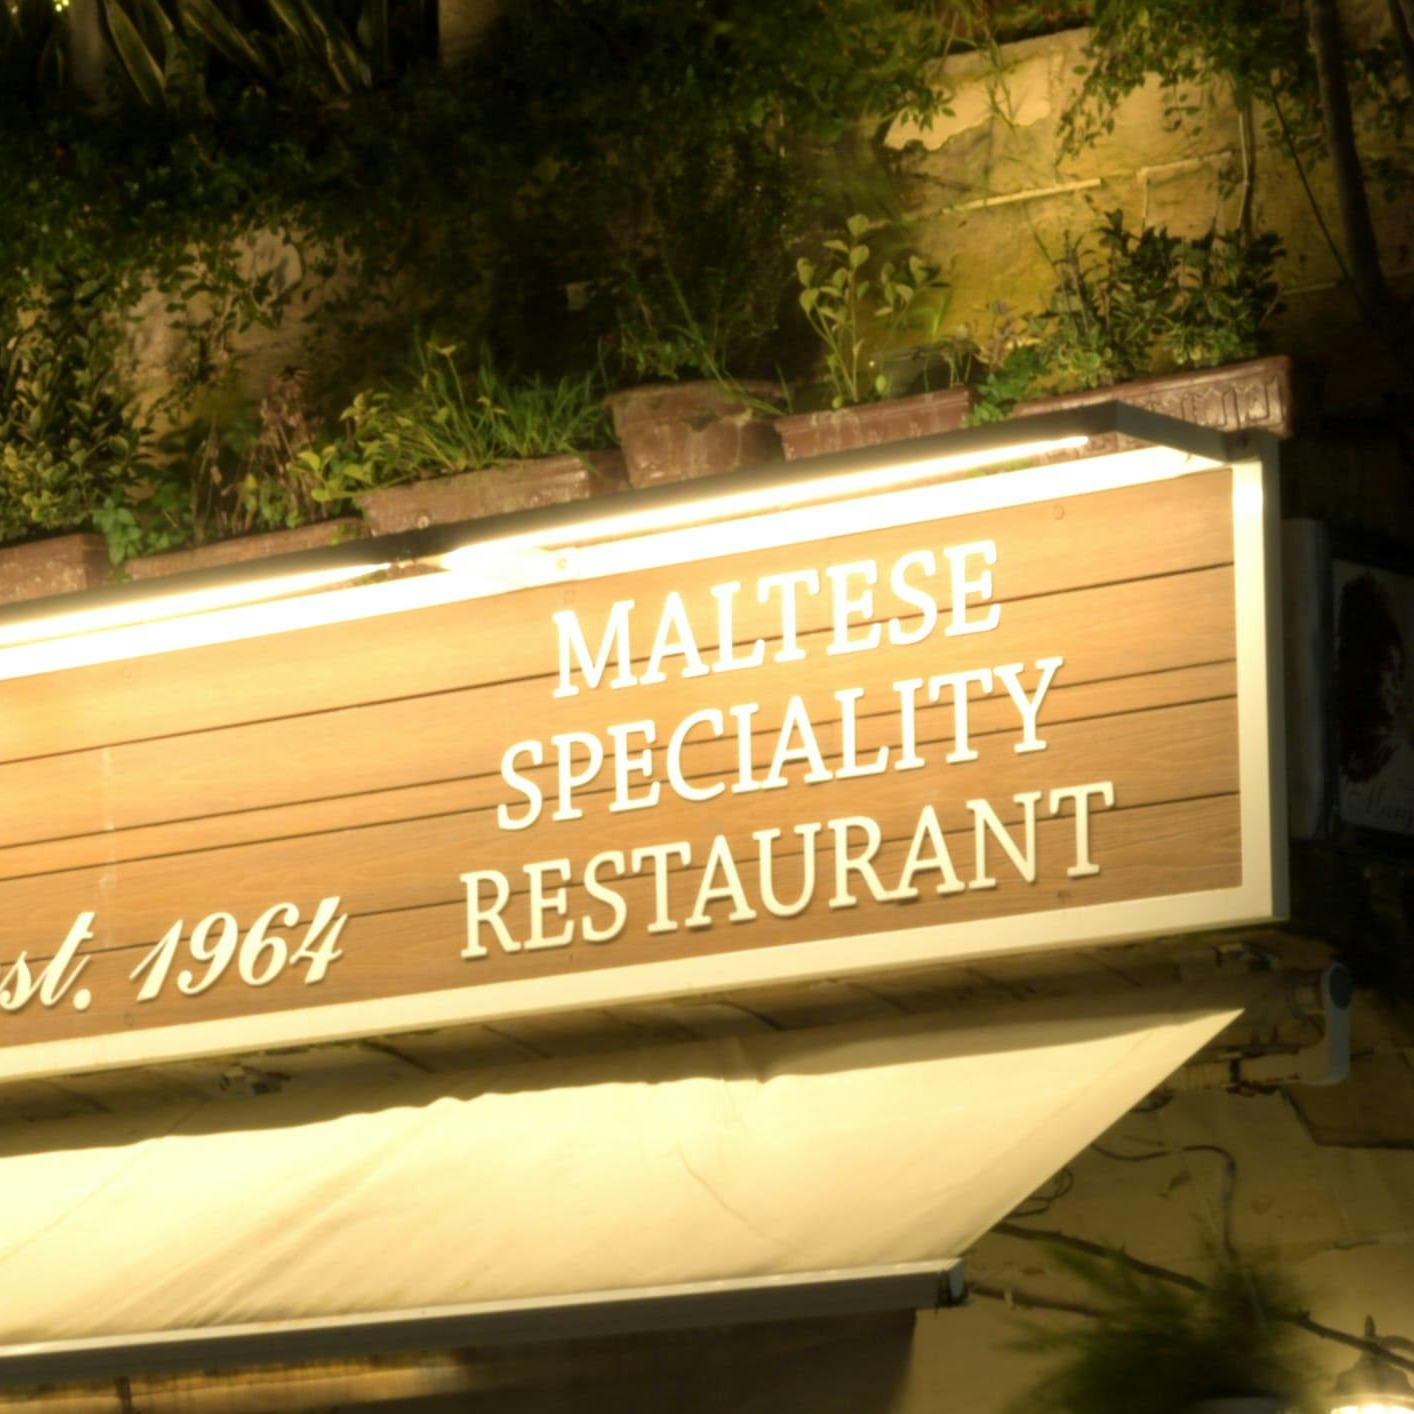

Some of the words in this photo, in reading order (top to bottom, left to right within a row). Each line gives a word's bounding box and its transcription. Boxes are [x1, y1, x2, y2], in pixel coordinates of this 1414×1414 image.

[551, 538, 1002, 699] MALTESE
[496, 655, 1066, 833] SPECIALITY
[128, 896, 348, 1002] 1964
[459, 780, 1116, 961] RESTAURANT
